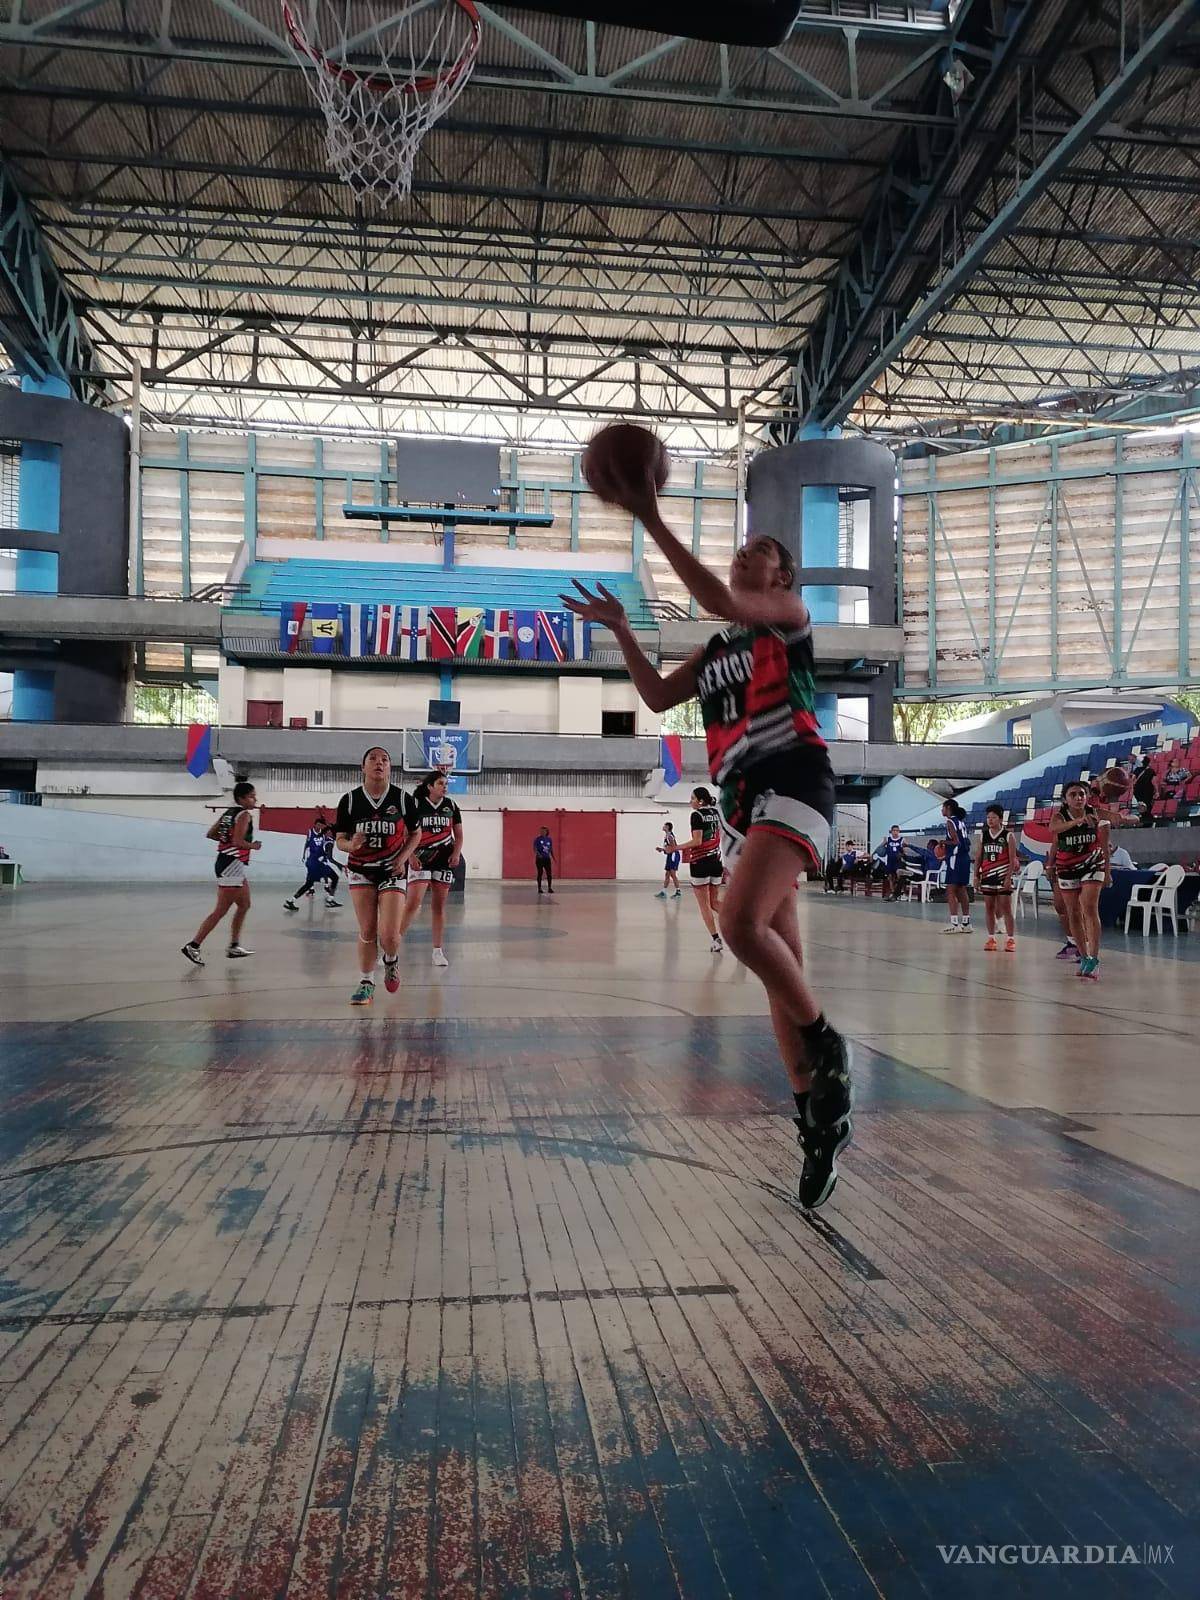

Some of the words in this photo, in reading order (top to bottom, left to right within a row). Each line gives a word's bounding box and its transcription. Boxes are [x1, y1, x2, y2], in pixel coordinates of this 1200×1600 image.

[698, 650, 754, 702] MEXICO
[422, 816, 450, 827] MEXICO
[355, 821, 396, 835] MEXICO
[369, 837, 382, 848] 21
[1065, 834, 1097, 846] MEXICO
[984, 844, 1003, 854] MEXICO
[990, 854, 996, 862] 6
[440, 870, 452, 882] 18
